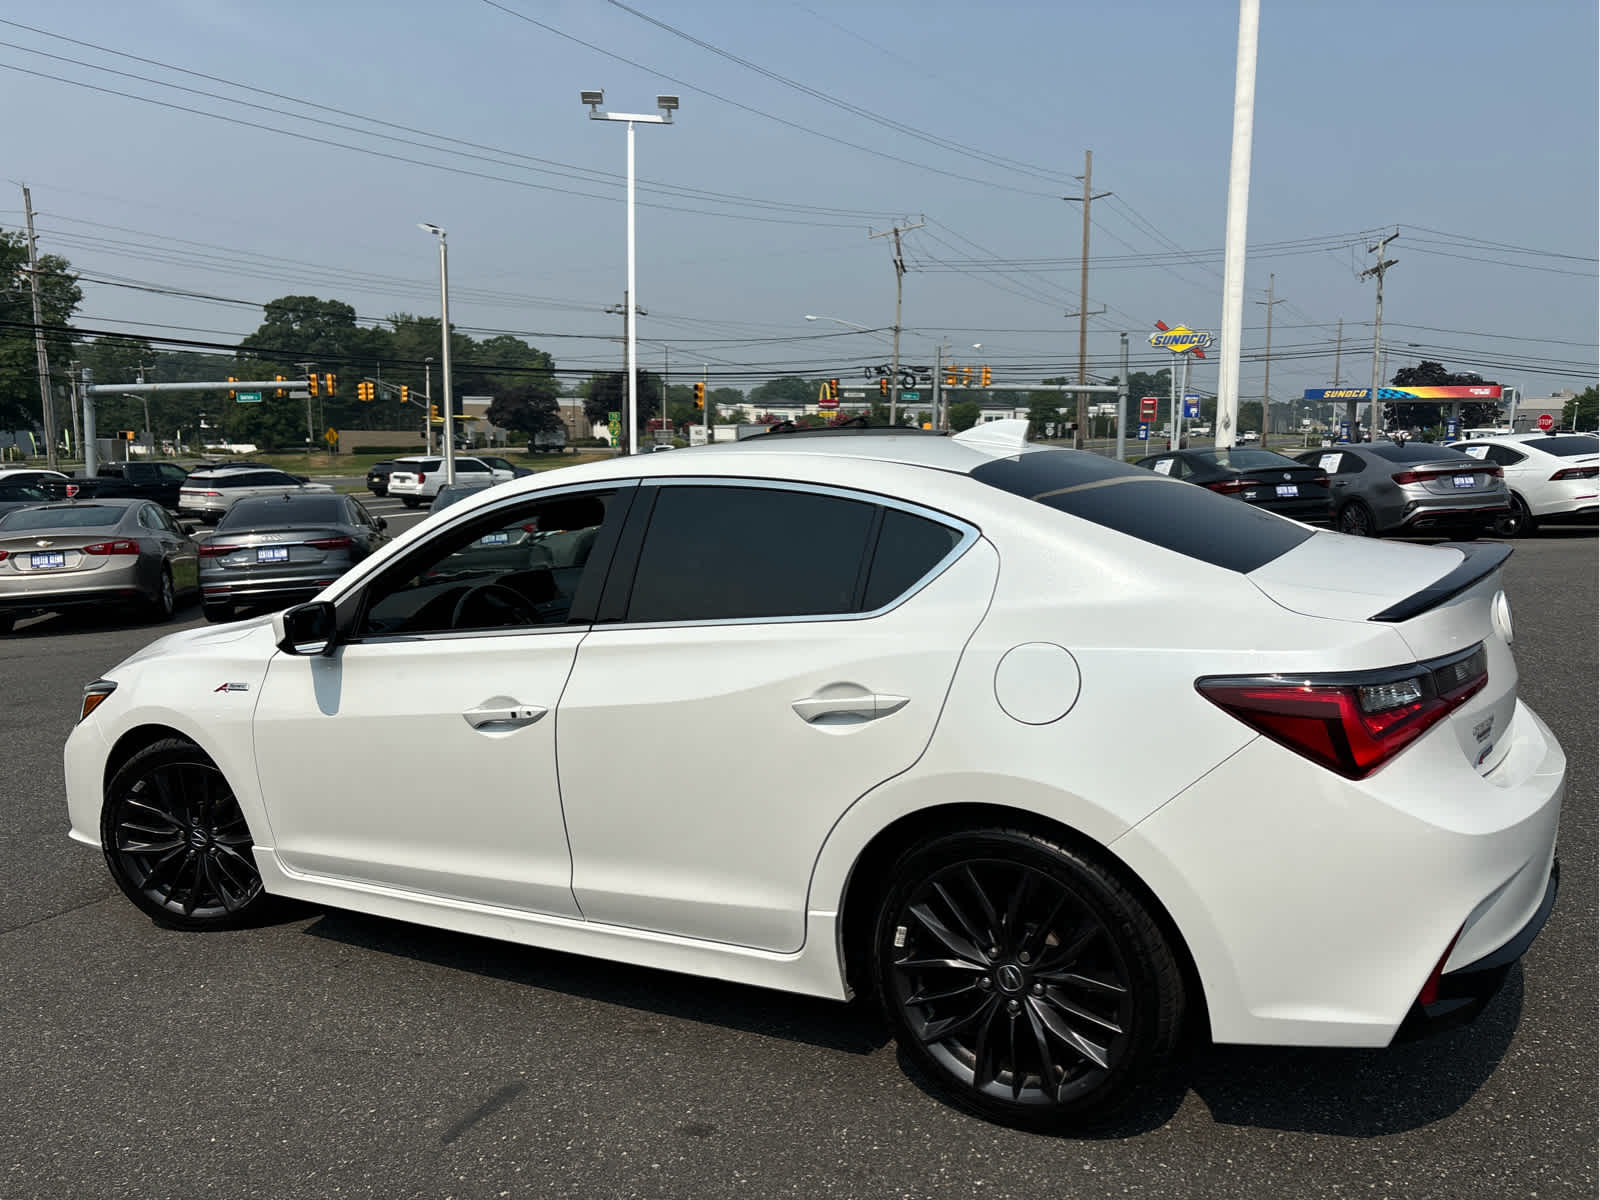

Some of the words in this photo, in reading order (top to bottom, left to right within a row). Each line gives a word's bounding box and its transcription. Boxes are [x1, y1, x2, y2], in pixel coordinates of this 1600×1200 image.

[1153, 334, 1207, 346] SUNOCO
[1323, 390, 1367, 399] SUNOCO
[1538, 418, 1553, 426] STOP
